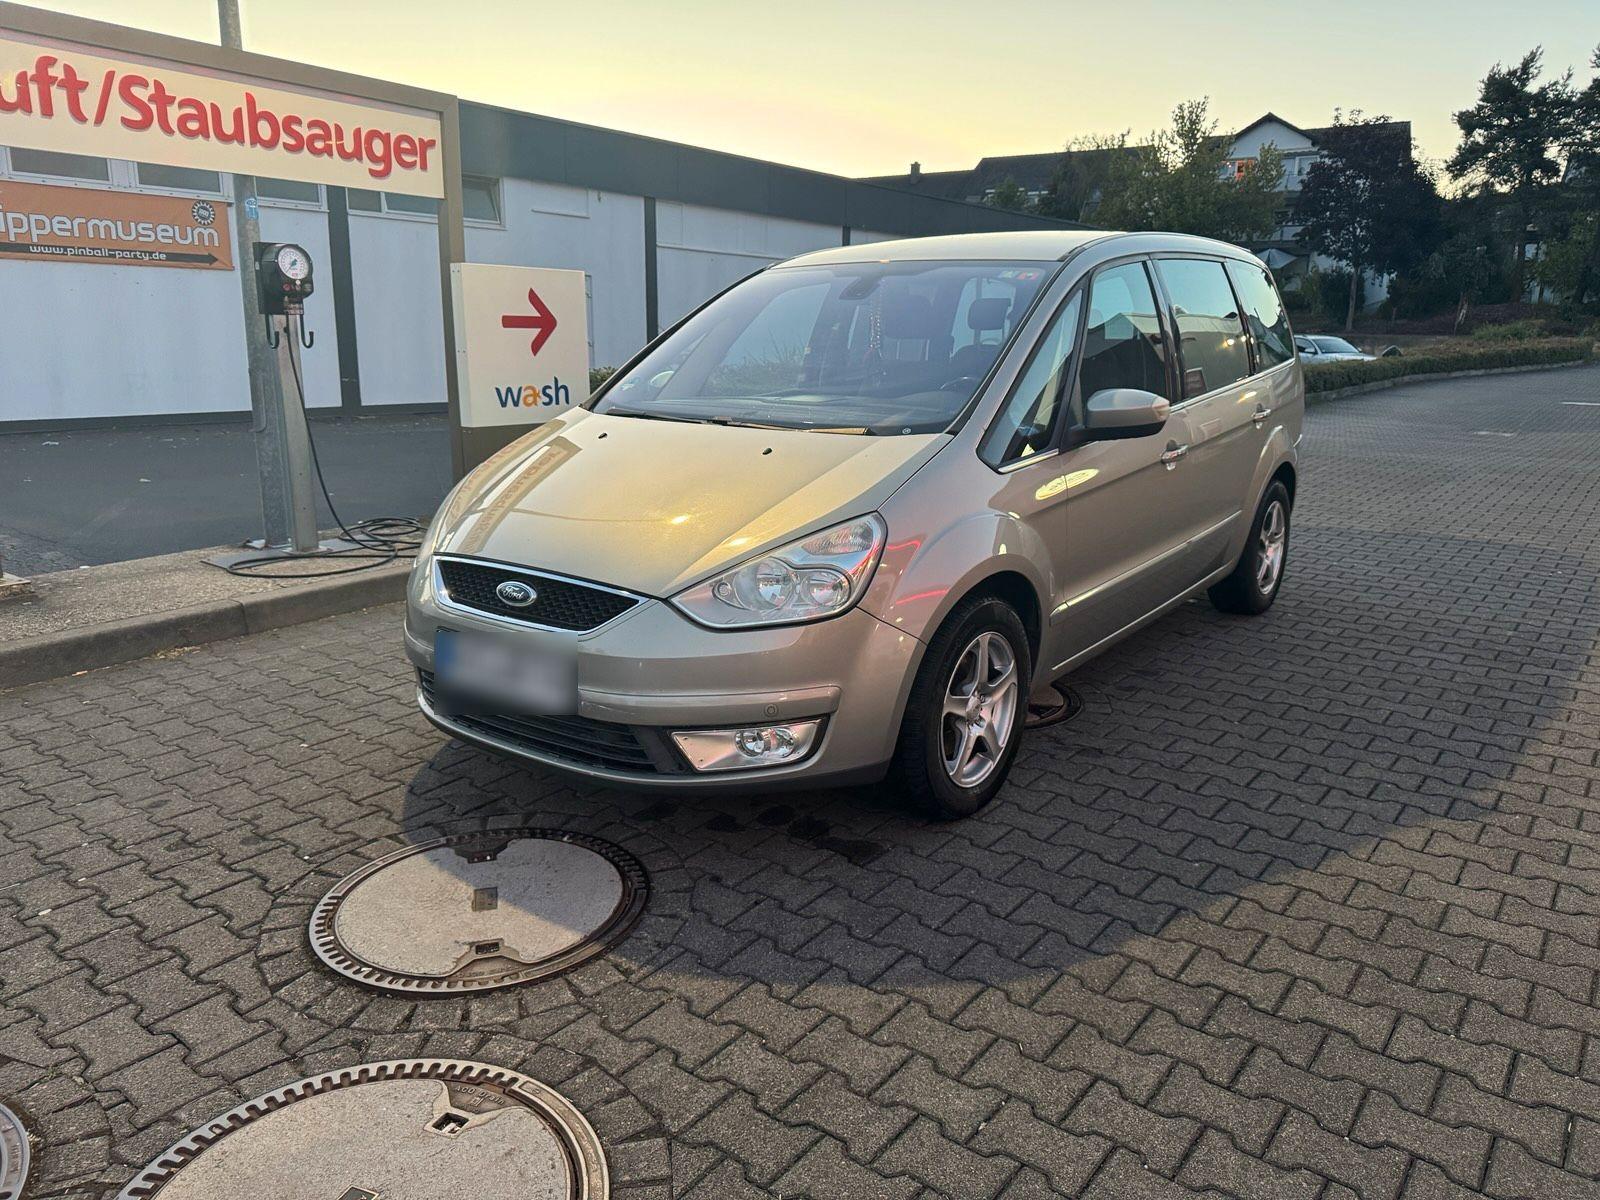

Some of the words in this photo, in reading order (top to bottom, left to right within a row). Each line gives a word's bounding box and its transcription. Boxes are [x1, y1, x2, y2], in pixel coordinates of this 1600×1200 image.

[29, 245, 167, 261] www.pinball-party.de
[495, 375, 570, 408] wash
[502, 585, 525, 600] Ford
